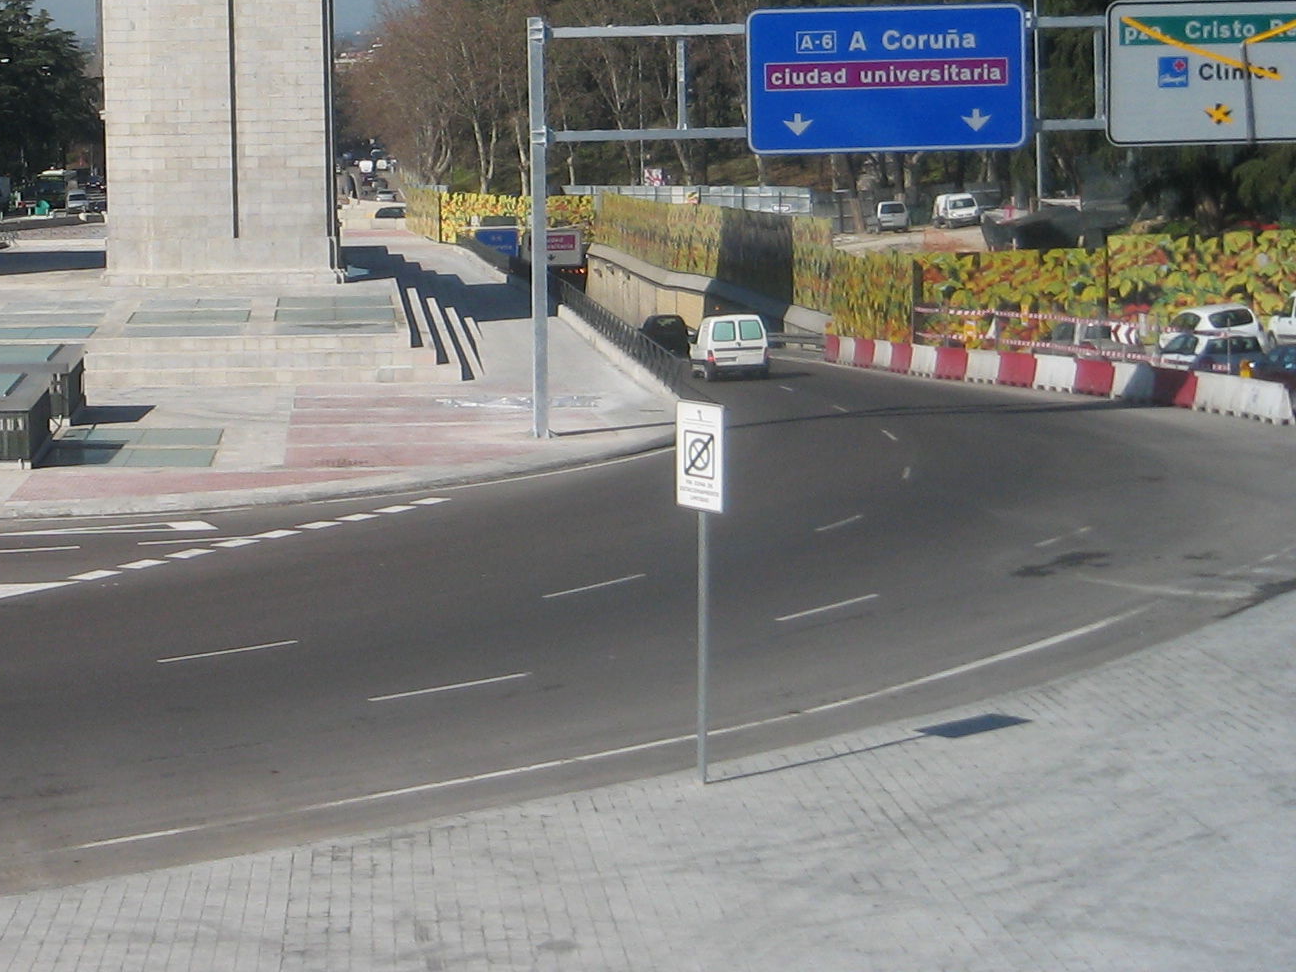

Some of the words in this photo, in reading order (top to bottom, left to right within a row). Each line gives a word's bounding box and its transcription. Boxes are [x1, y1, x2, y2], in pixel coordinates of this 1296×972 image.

[800, 34, 833, 49] A-6
[849, 30, 867, 51] A
[882, 28, 977, 51] Coruña
[1184, 20, 1255, 39] Cristo
[770, 67, 847, 86] ciudad
[859, 64, 1002, 84] universitaria
